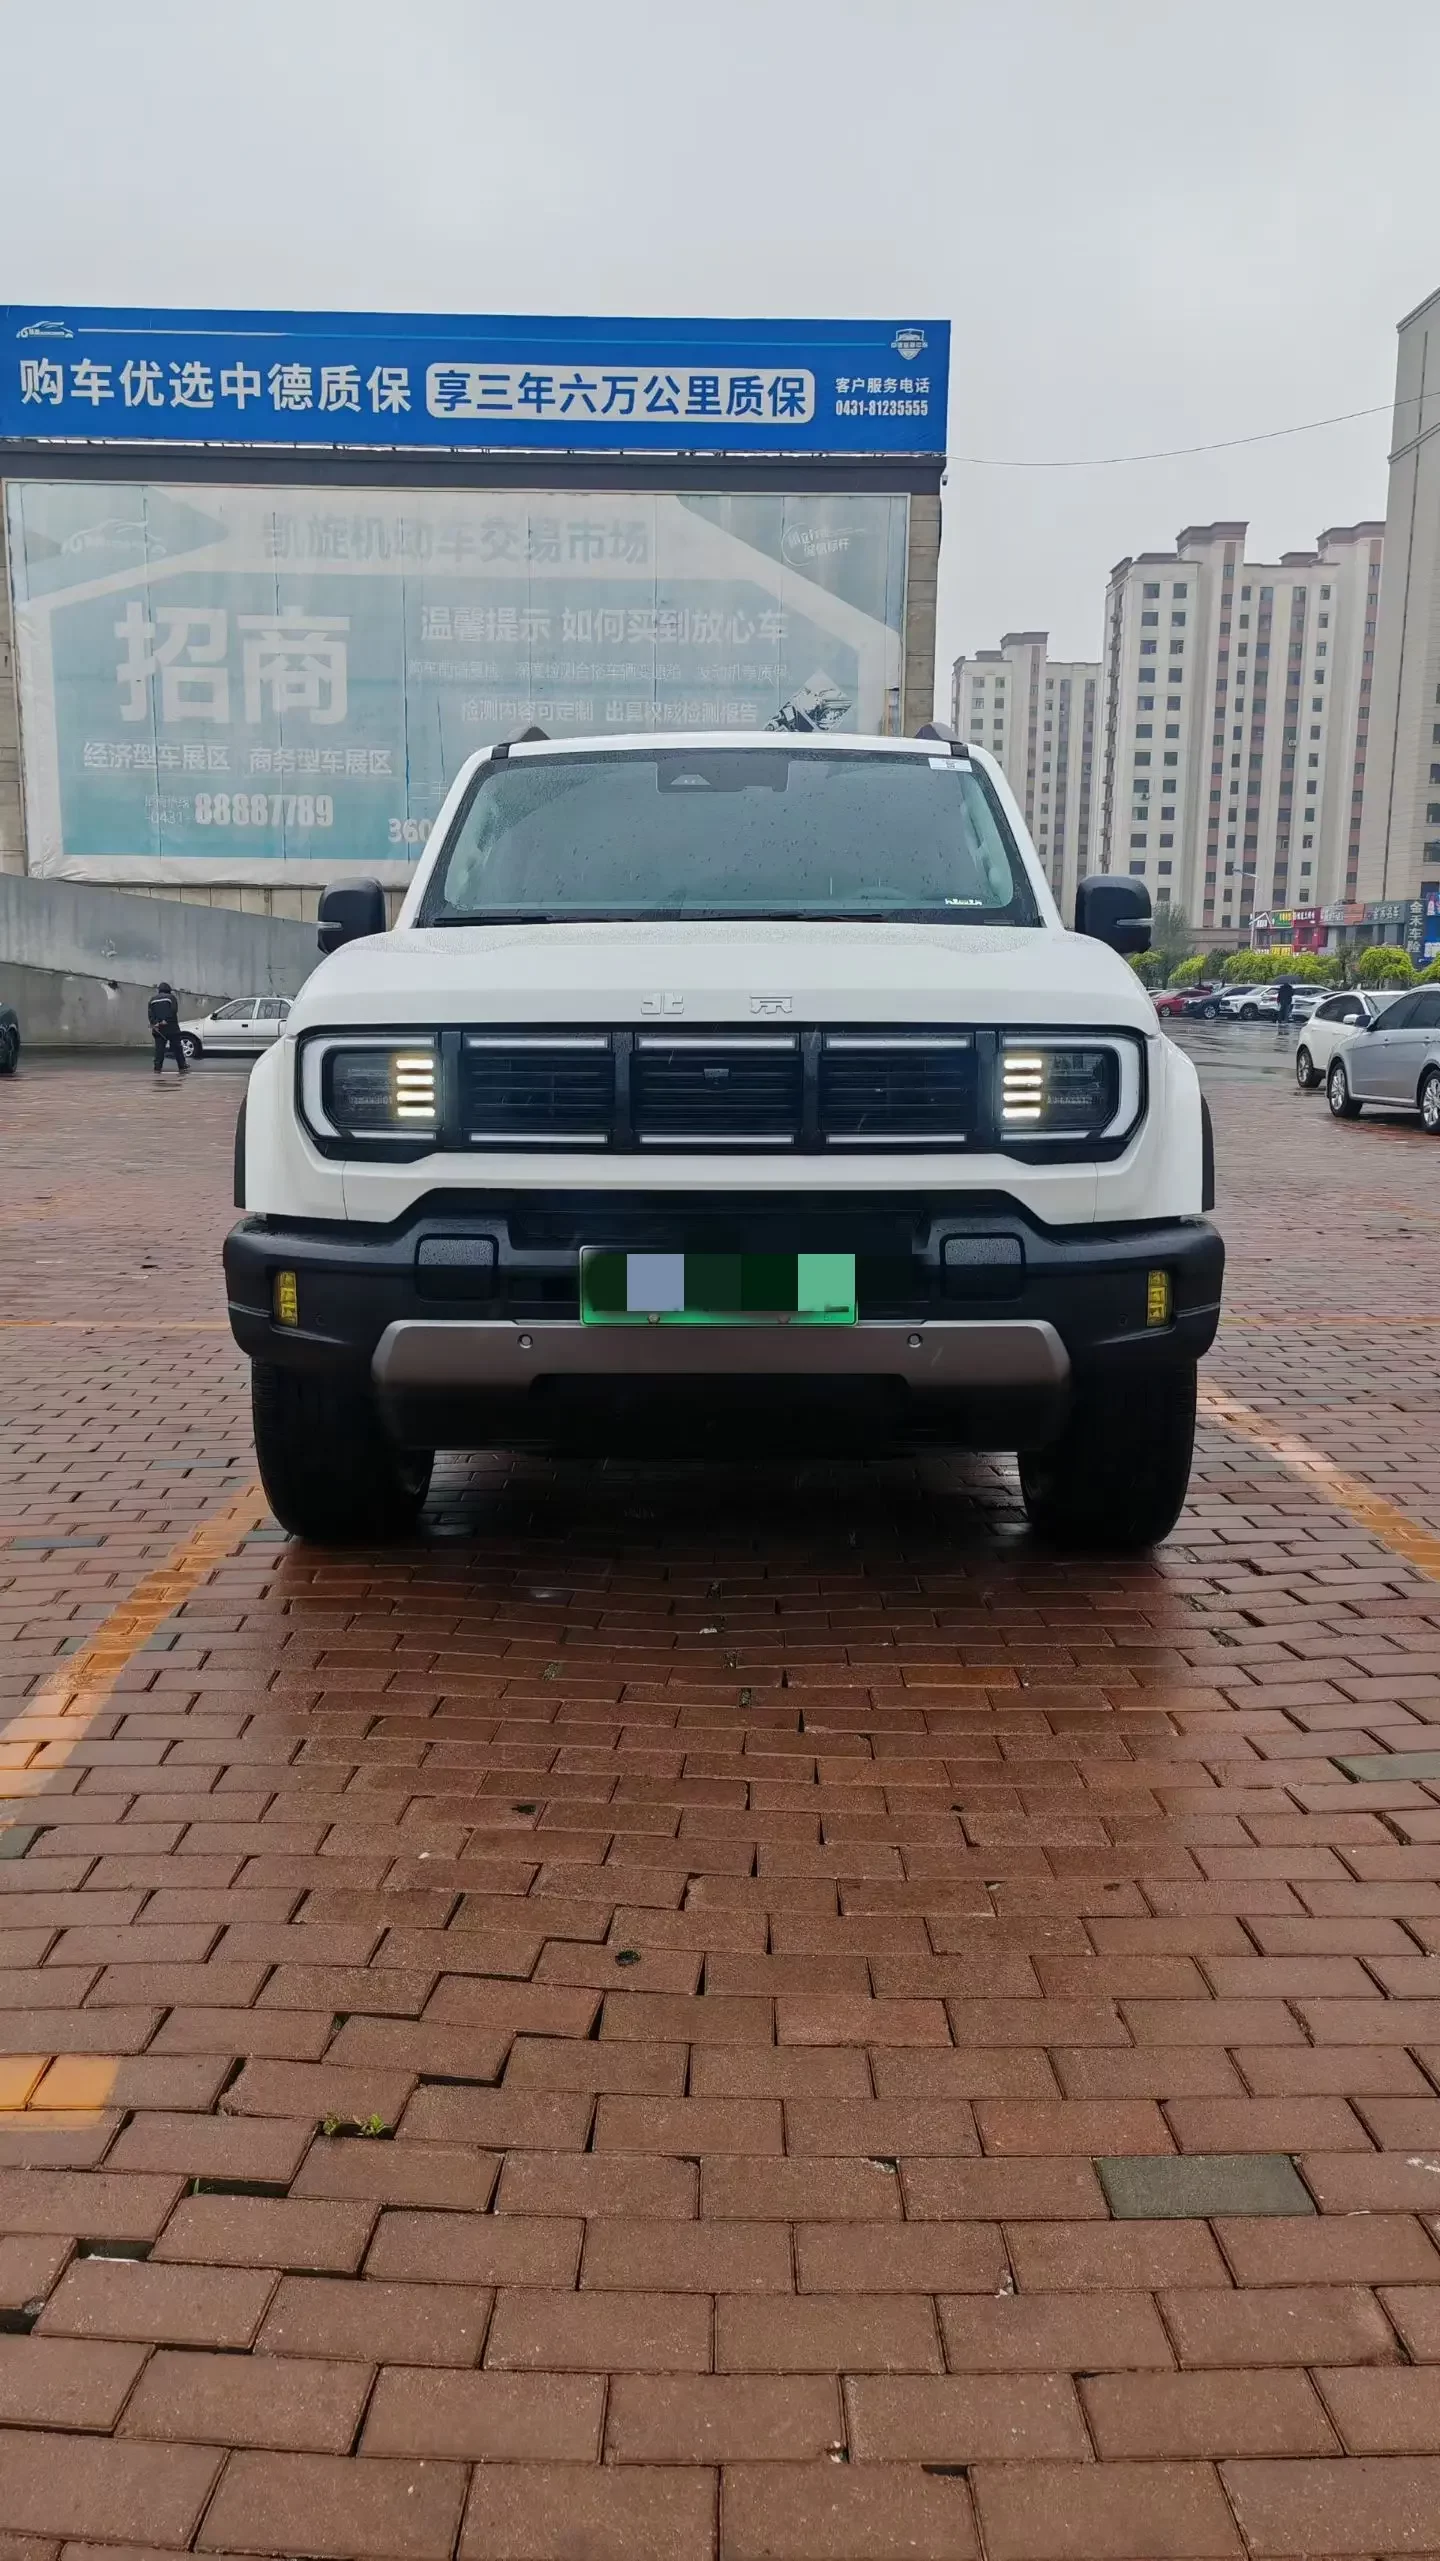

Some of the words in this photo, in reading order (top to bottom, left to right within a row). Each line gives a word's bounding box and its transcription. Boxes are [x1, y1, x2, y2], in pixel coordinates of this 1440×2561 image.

[19, 357, 412, 414] 购车优选中德质保
[433, 369, 807, 418] 享三年六万公里质保
[835, 376, 931, 395] 客户服务电话
[835, 399, 929, 417] 0431-81235555
[261, 511, 649, 564] 凯旋机动车交易市场
[421, 606, 550, 643] 温馨提示
[561, 606, 789, 643] 如何买到放心车
[114, 601, 350, 725] 招商
[462, 700, 593, 722] 检测内容可定制
[83, 742, 230, 772] 经济型车展区
[249, 746, 391, 775] 商务型车展区
[195, 792, 334, 827] 88887789
